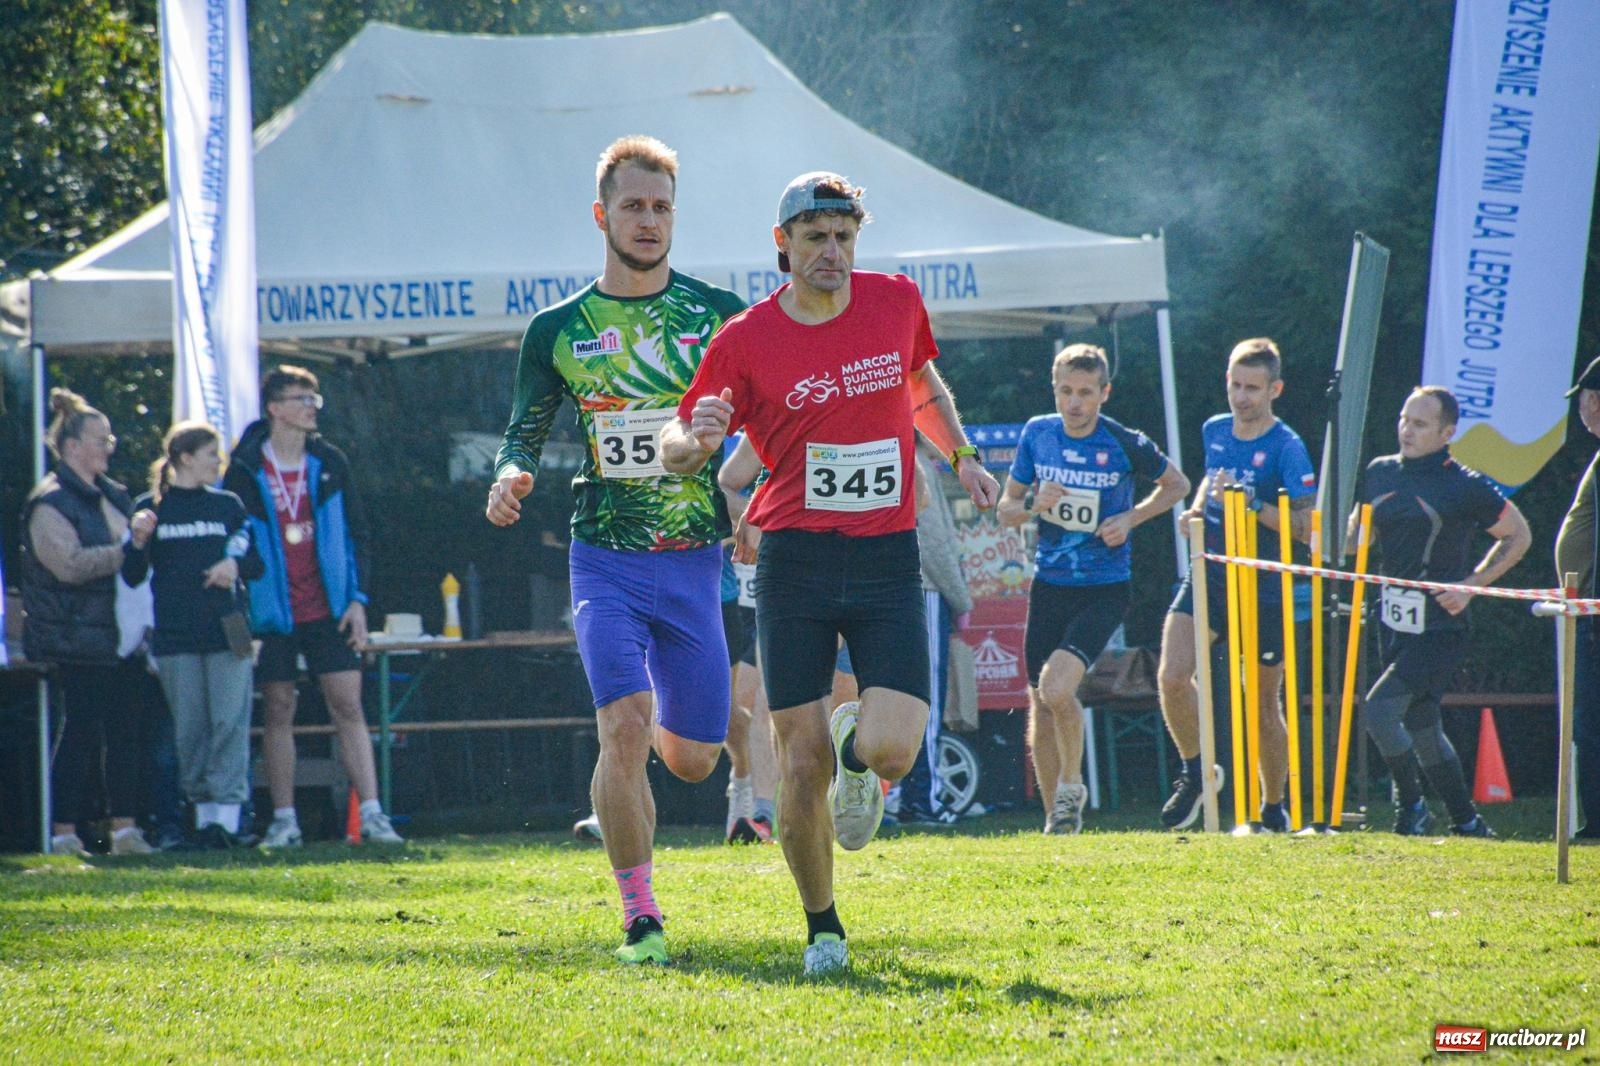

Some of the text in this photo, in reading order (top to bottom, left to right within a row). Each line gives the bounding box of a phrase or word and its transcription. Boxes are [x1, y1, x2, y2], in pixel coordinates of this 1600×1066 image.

[1481, 103, 1533, 194] AKTYWNI
[1473, 202, 1519, 239] DLA
[1463, 248, 1512, 351] LEPSZEGO
[841, 352, 900, 375] MARCONI
[843, 365, 902, 386] DUATHLON
[846, 375, 902, 397] ŚWIDNICA
[1455, 358, 1497, 419] JUTRA
[603, 435, 656, 466] 35
[812, 465, 897, 498] 345
[1034, 464, 1120, 488] RUNNERS
[1048, 503, 1093, 524] 60
